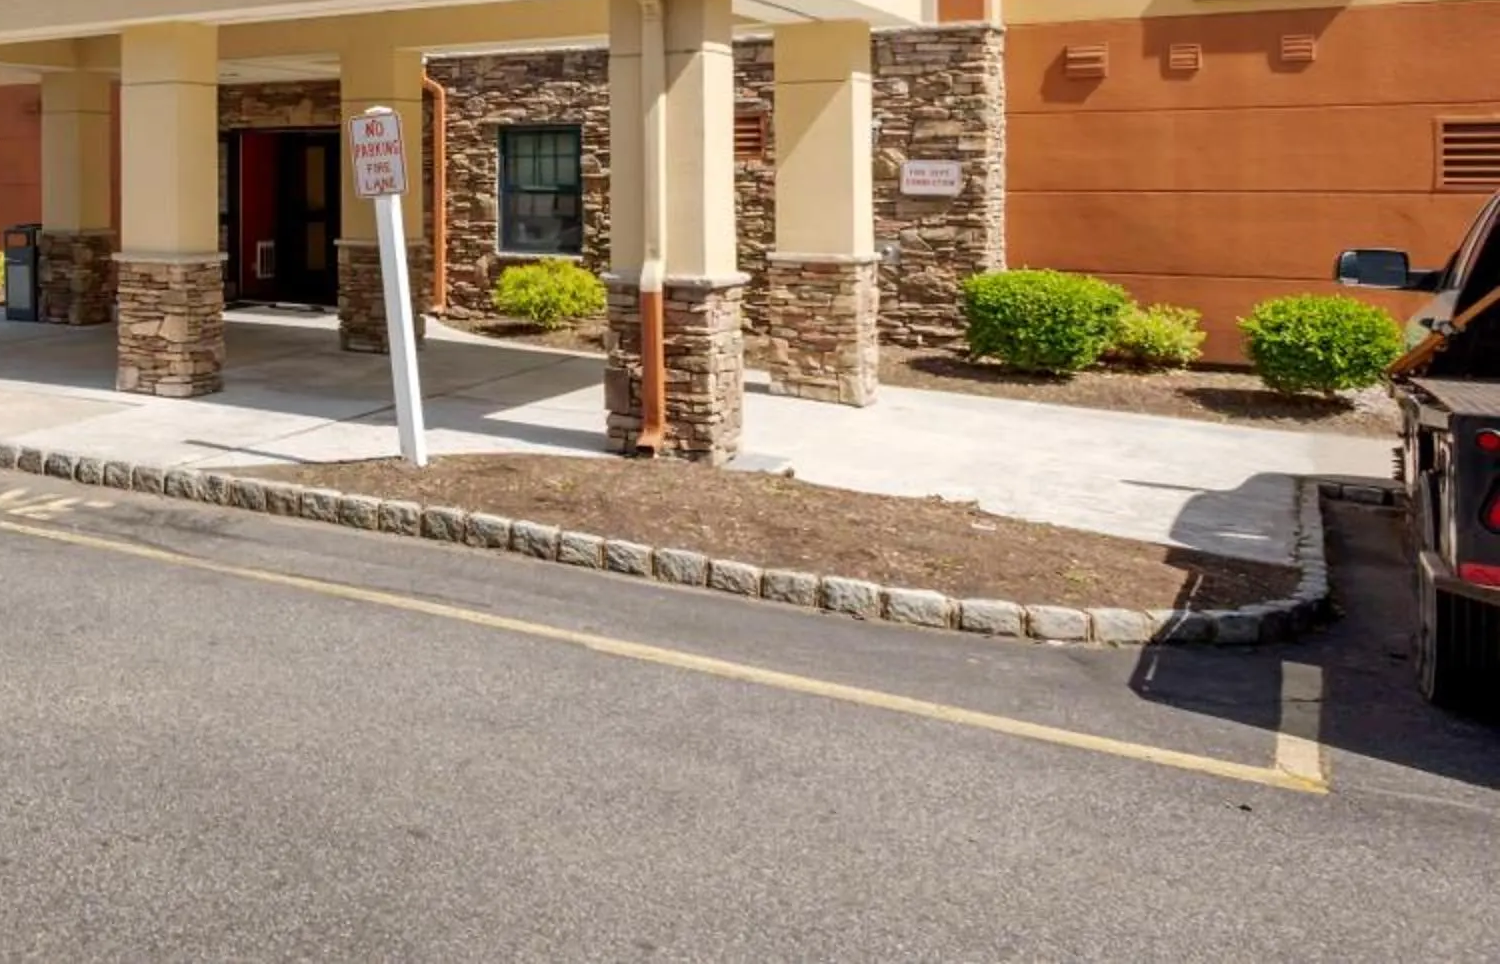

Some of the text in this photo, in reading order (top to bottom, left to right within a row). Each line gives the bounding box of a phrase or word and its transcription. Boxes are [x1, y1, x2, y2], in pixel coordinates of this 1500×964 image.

[365, 119, 385, 137] NO
[355, 141, 400, 158] PARKING
[365, 161, 390, 174] FIRE
[365, 176, 397, 192] LANE
